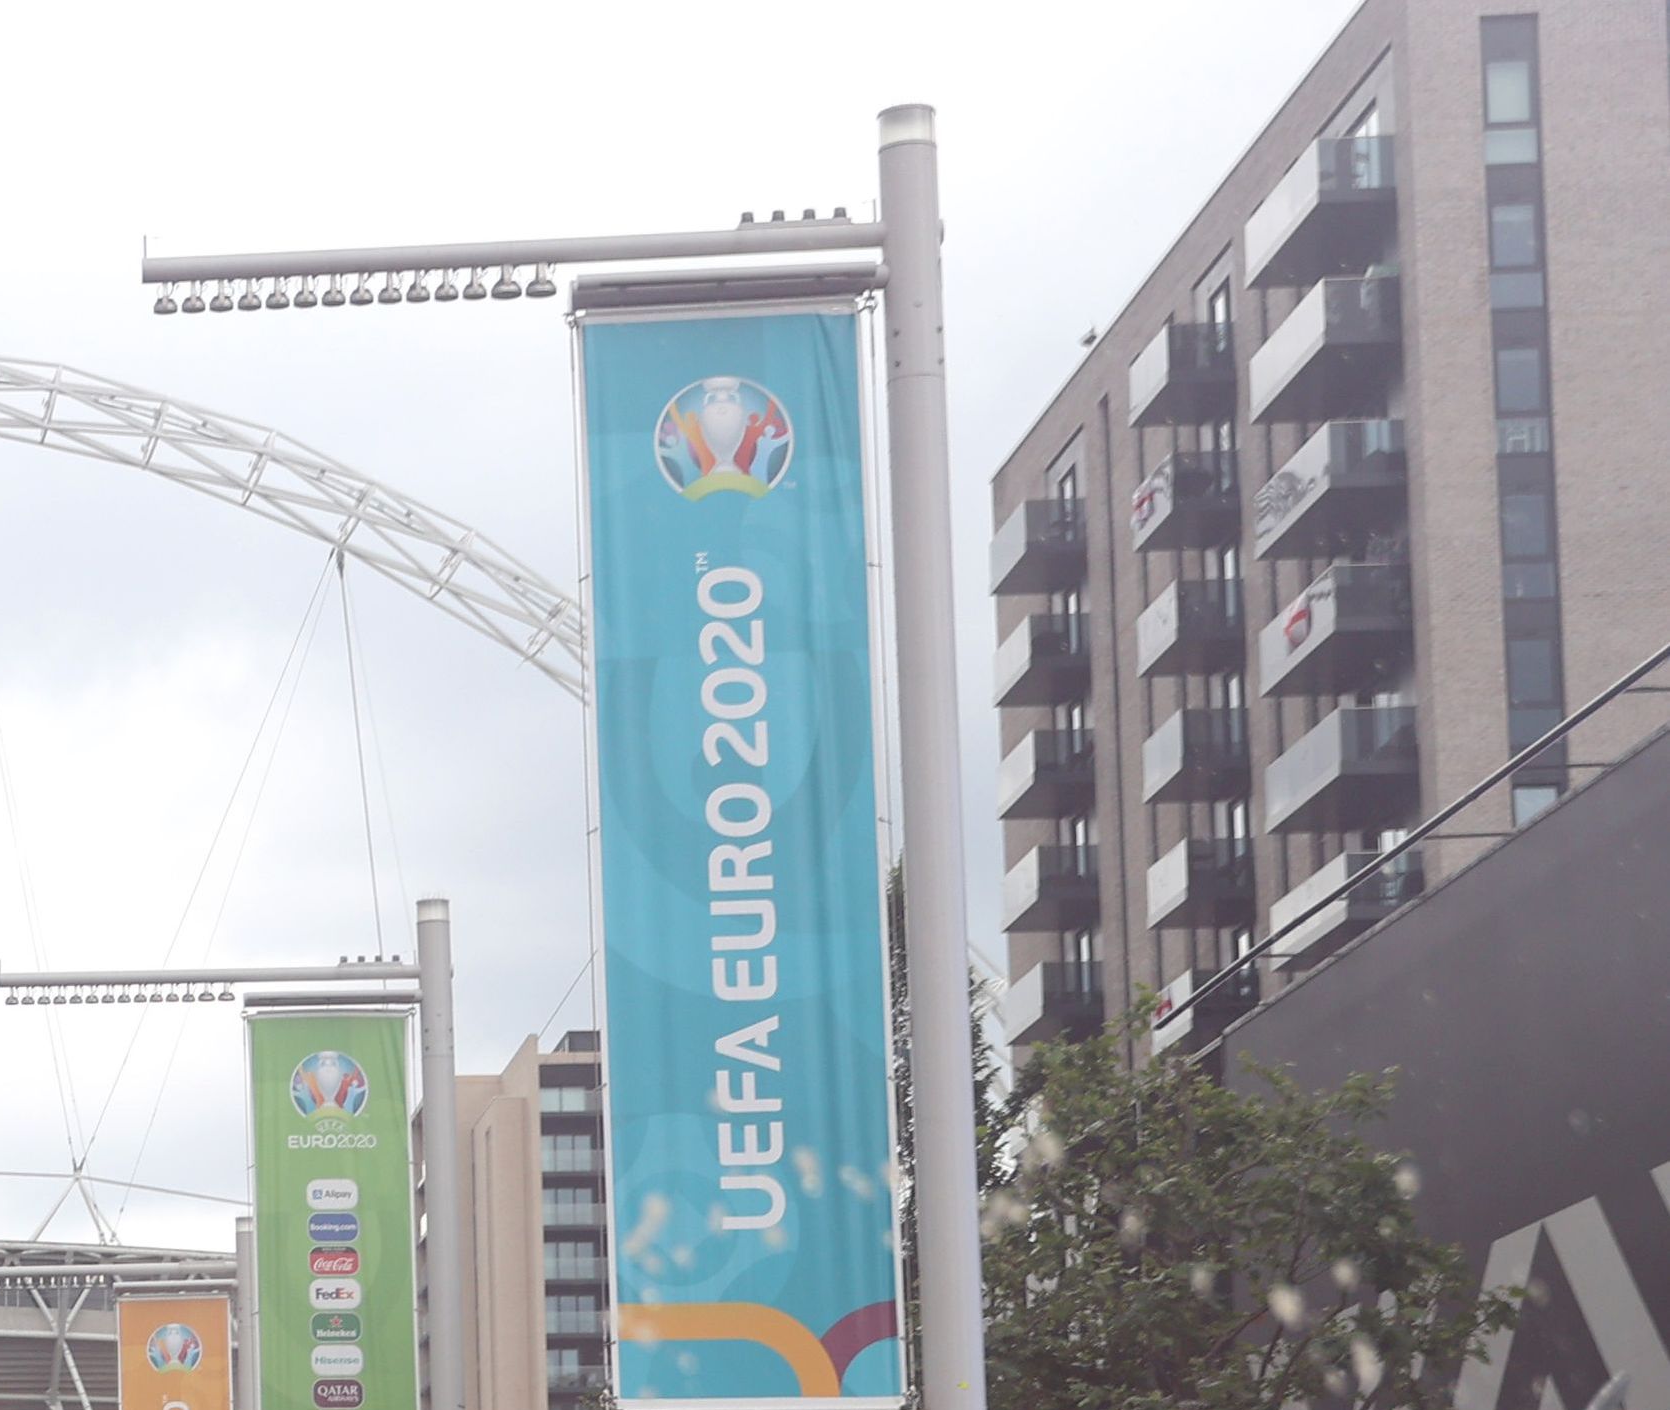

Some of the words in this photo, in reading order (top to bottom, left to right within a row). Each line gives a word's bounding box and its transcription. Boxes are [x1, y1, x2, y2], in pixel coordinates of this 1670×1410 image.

[696, 566, 769, 768] 2020
[705, 783, 778, 1002] EURO
[715, 1014, 787, 1231] UEFA
[323, 1189, 353, 1200] Alipay
[310, 1223, 356, 1233] Booking.com
[315, 1288, 355, 1300] FedEx
[314, 1356, 359, 1365] Hisense
[317, 1385, 359, 1398] QATAR
